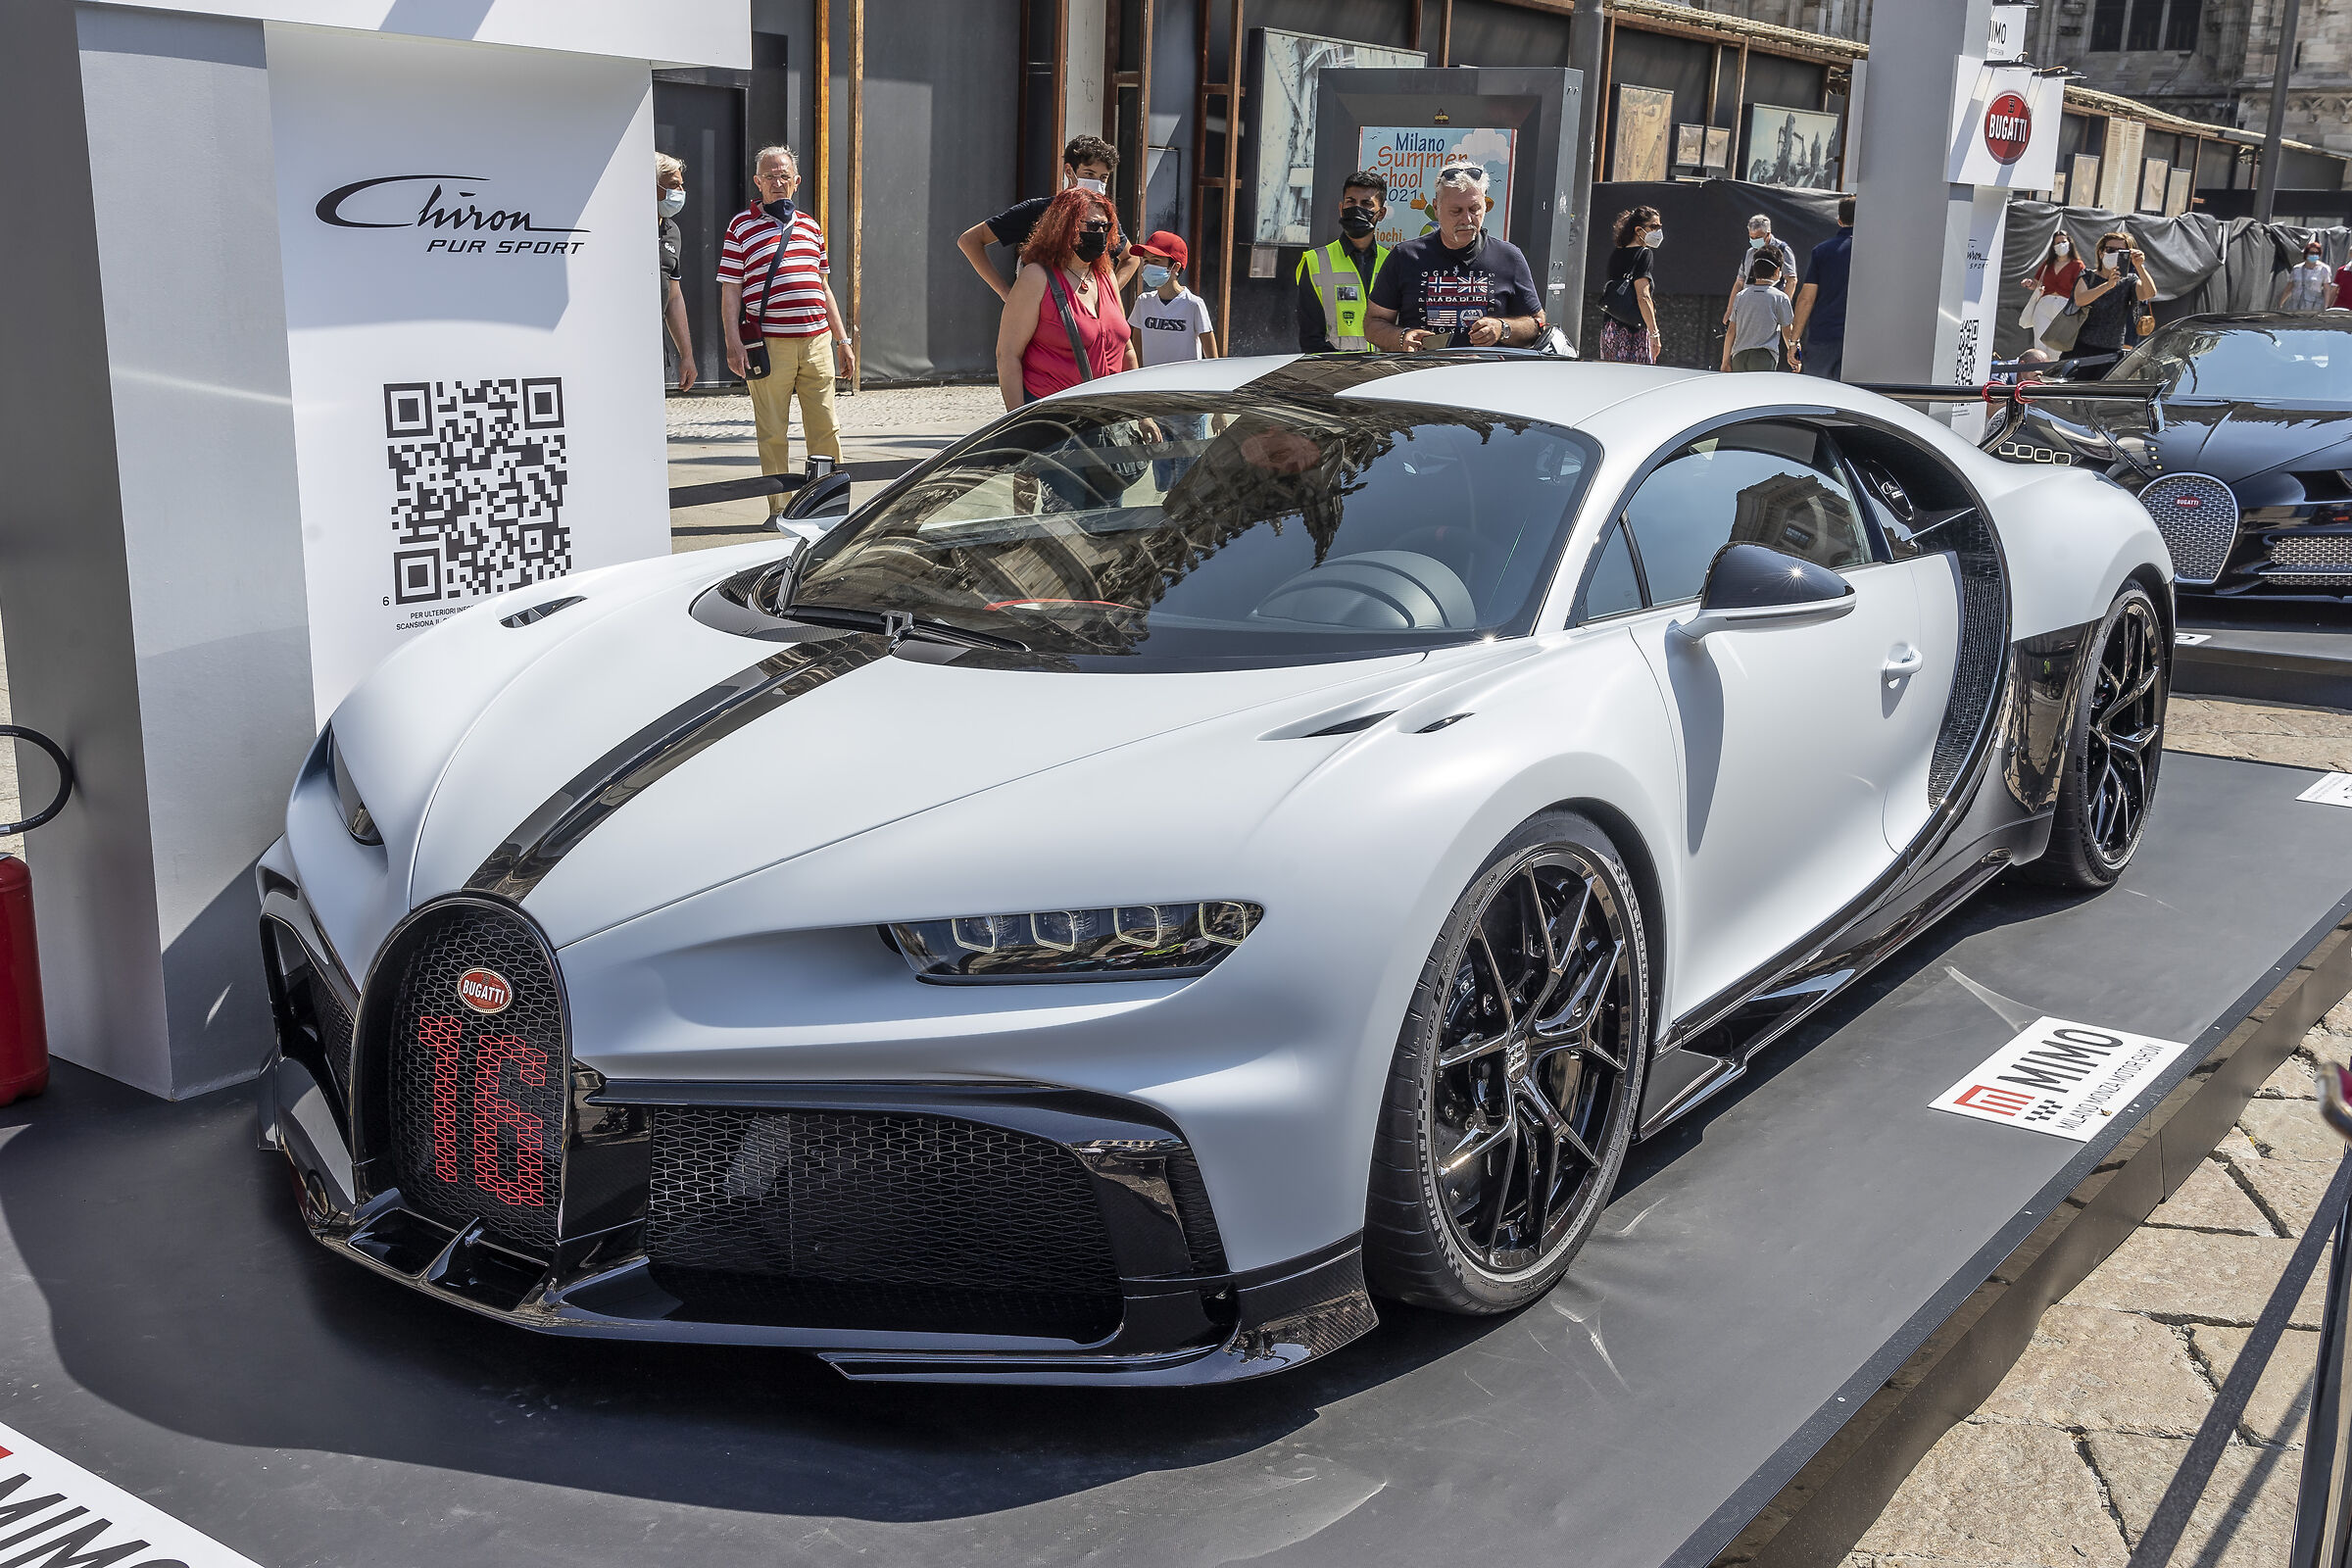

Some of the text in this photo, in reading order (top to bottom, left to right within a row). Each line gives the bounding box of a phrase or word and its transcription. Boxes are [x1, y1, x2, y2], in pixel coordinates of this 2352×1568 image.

[1988, 20, 2007, 44] IMO
[1988, 114, 2028, 143] BUGATTI
[1396, 132, 1445, 152] Milano
[1368, 166, 1423, 189] chool
[316, 174, 591, 233] Chiron
[1385, 188, 1418, 202] 021
[426, 239, 586, 255] PUR SPORT
[1145, 317, 1187, 331] GUESS
[382, 596, 390, 607] 6
[424, 608, 456, 617] ULTERIORI
[396, 619, 434, 631] SCANSIONA
[463, 979, 505, 1004] BUGATTI
[1996, 1028, 2125, 1094] MIMO
[2055, 1043, 2165, 1131] MILANO MONZA MOTOR SHOW
[1419, 1139, 1442, 1232] MICHELIN
